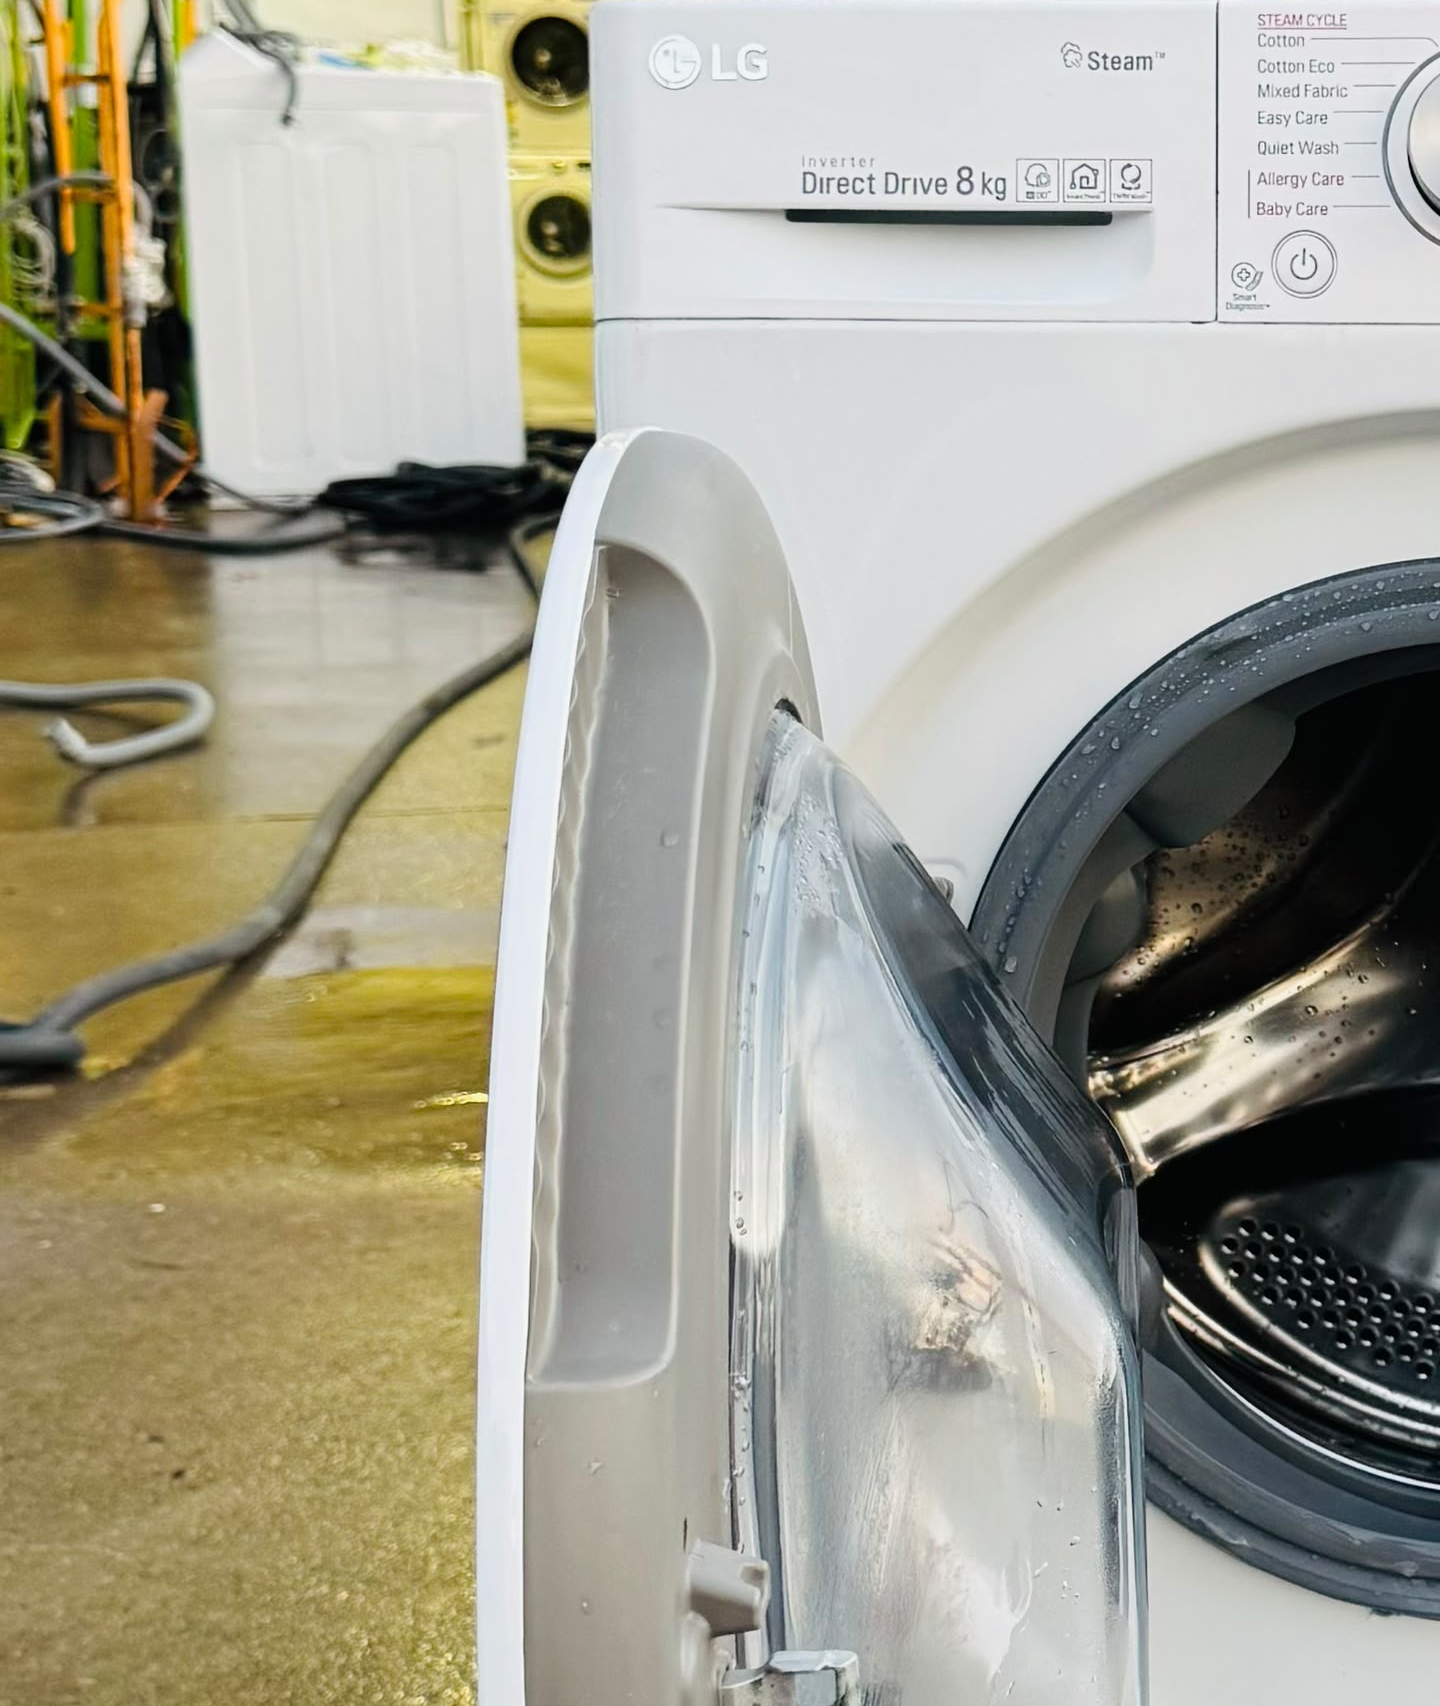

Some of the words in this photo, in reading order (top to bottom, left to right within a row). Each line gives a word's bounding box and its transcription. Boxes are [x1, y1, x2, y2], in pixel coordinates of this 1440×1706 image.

[1257, 13, 1303, 27] STEAM
[1306, 13, 1348, 27] CYCLE
[1257, 33, 1305, 48] Cotton
[711, 42, 769, 81] LG
[1257, 59, 1305, 74] Cotton
[1309, 59, 1335, 73] Eco
[1257, 84, 1301, 98] Mixed
[1304, 84, 1348, 98] Fabric
[1257, 111, 1292, 128] Easy
[1295, 110, 1328, 125] Care
[1257, 140, 1295, 155] Quiet
[1299, 140, 1339, 155] Wash
[801, 155, 876, 169] Inverter
[801, 171, 876, 196] Direct
[883, 171, 948, 196] Drive
[955, 165, 975, 197] 8
[981, 171, 1007, 201] kg
[1257, 172, 1308, 189] Allergy
[1311, 171, 1345, 186] Care
[1256, 202, 1292, 218] Baby
[1296, 201, 1329, 216] Care
